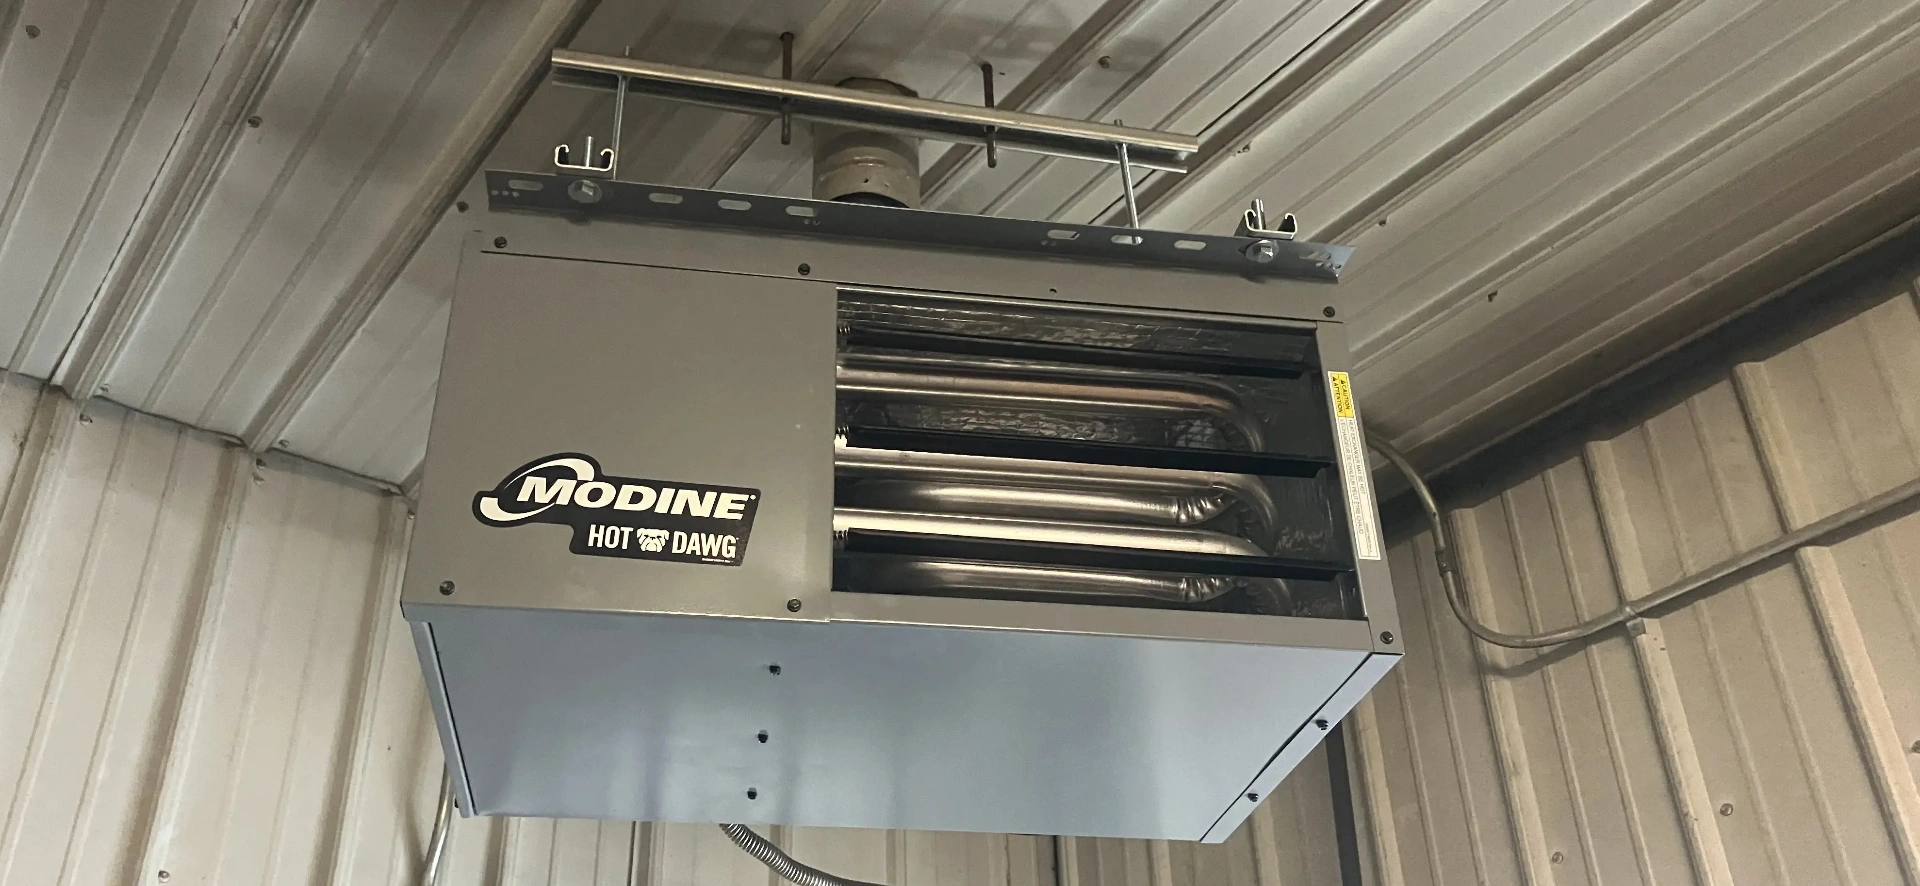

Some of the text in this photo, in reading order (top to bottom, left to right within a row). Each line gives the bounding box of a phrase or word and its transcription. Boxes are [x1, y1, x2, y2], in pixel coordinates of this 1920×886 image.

[1333, 382, 1343, 412] ATTENTION
[1341, 385, 1350, 409] CAUTION
[517, 476, 750, 520] MODINE
[588, 524, 737, 558] HOT DAWG
